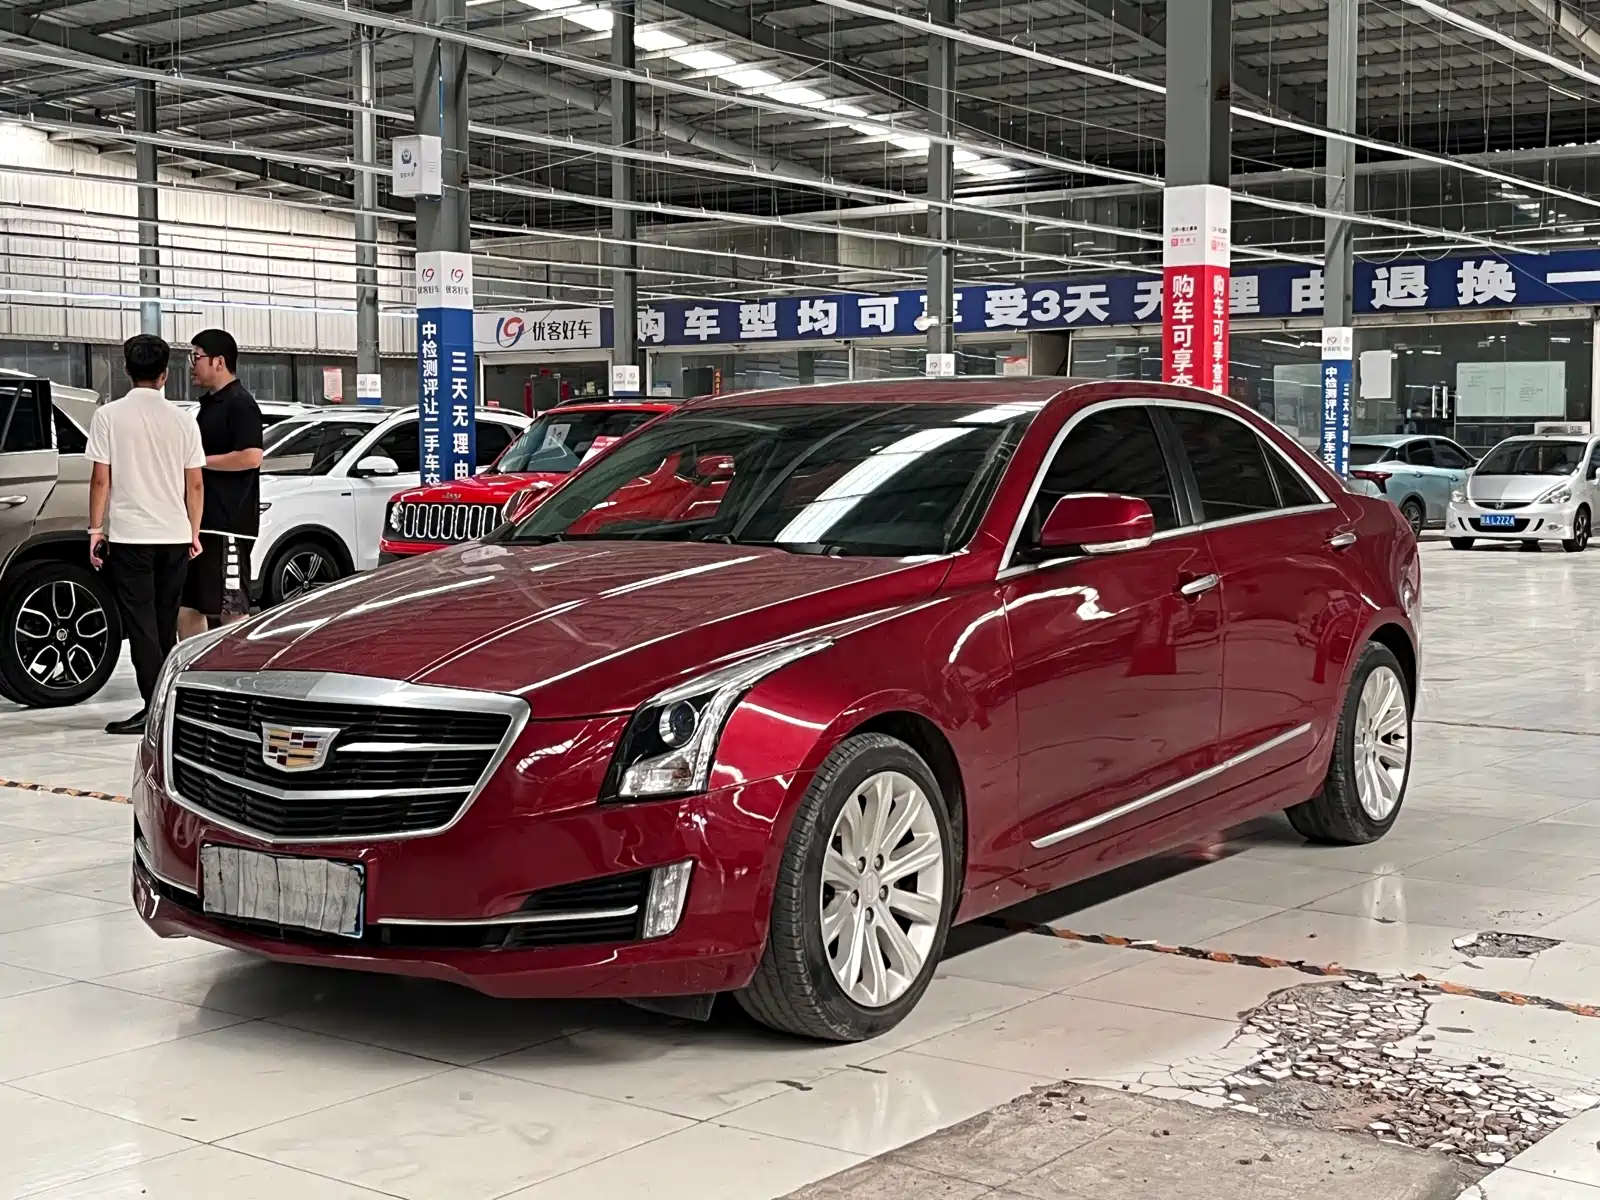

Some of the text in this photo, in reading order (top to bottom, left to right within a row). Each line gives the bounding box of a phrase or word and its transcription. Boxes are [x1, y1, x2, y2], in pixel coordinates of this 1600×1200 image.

[532, 319, 593, 342] 优客好车
[452, 351, 470, 481] 三天无理由
